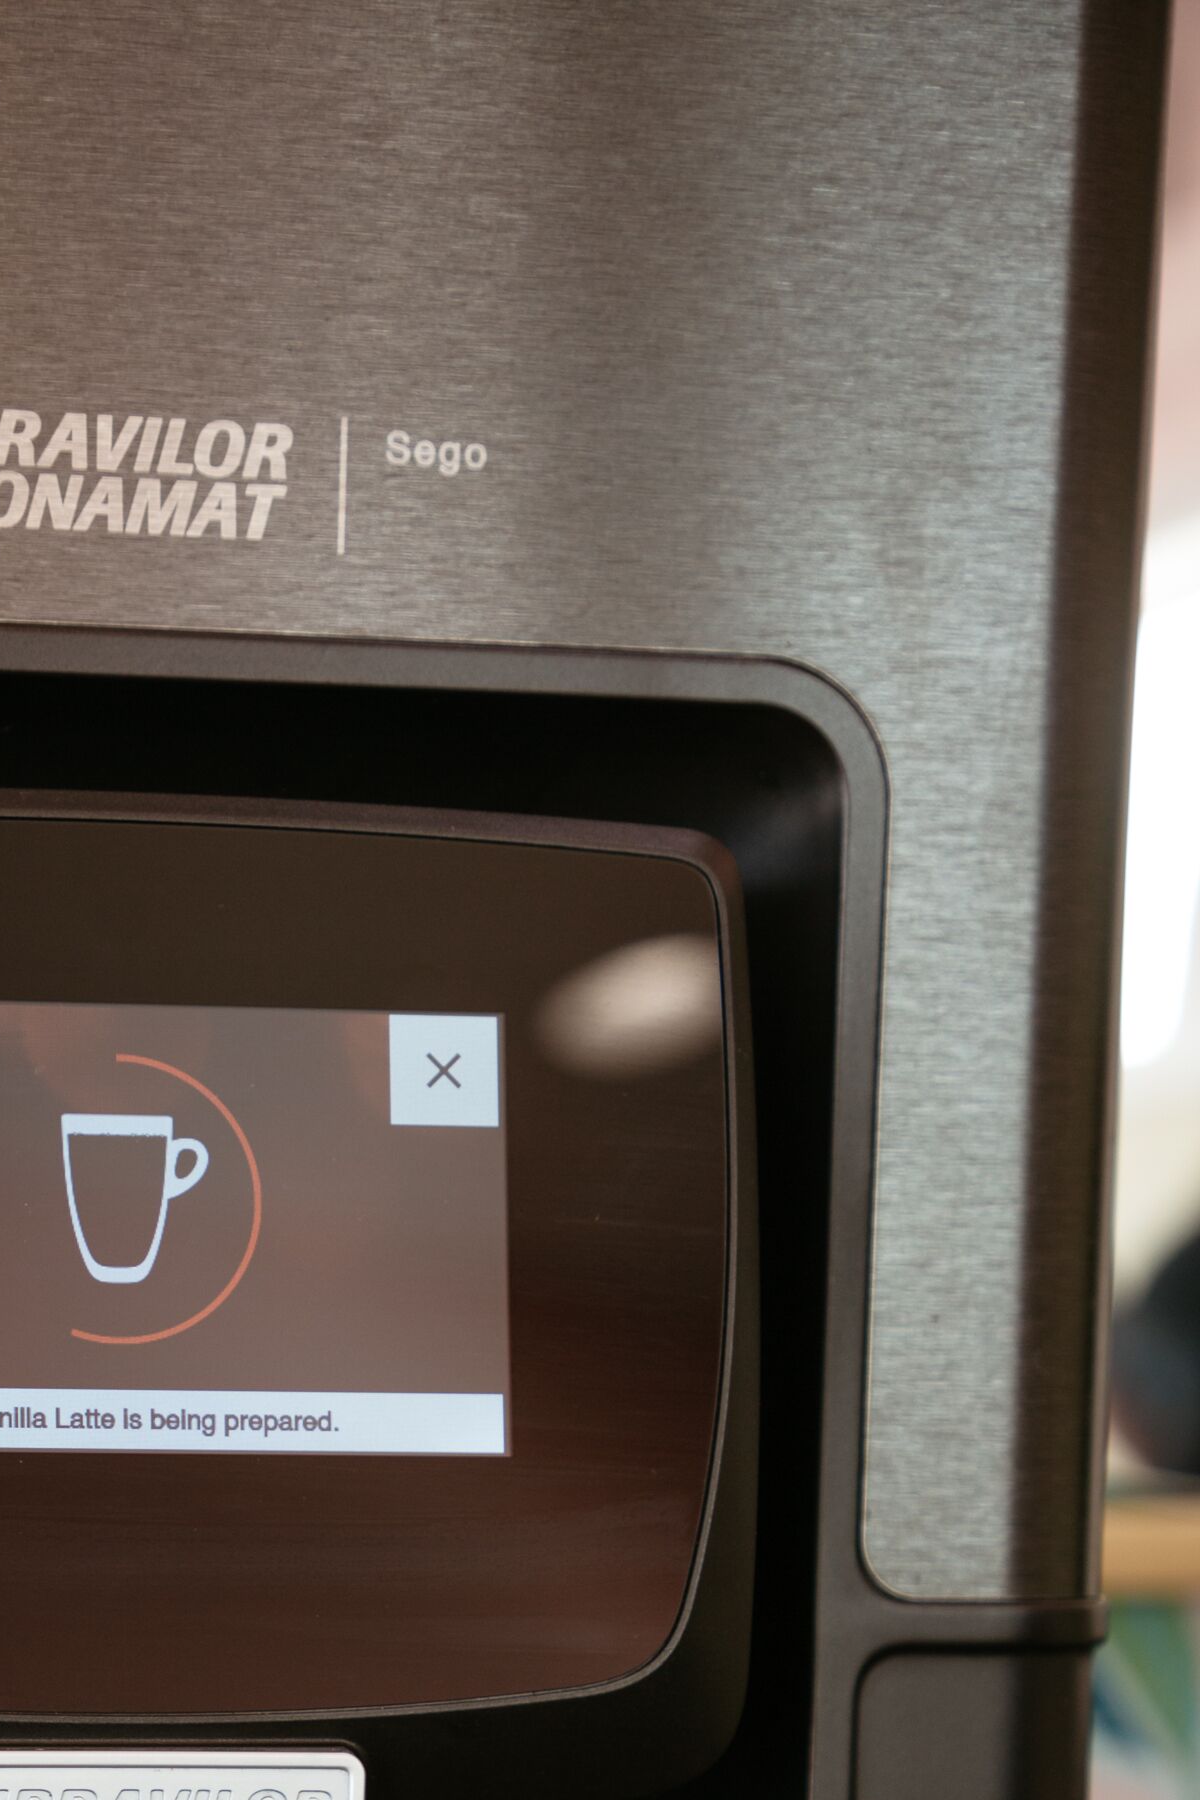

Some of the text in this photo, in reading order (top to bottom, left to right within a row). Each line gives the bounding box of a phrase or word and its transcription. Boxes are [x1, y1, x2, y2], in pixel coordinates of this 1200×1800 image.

[385, 429, 490, 475] Sego
[54, 1407, 116, 1431] Latte
[122, 1407, 143, 1432] is
[150, 1408, 217, 1438] being
[224, 1409, 340, 1438] prepared.
